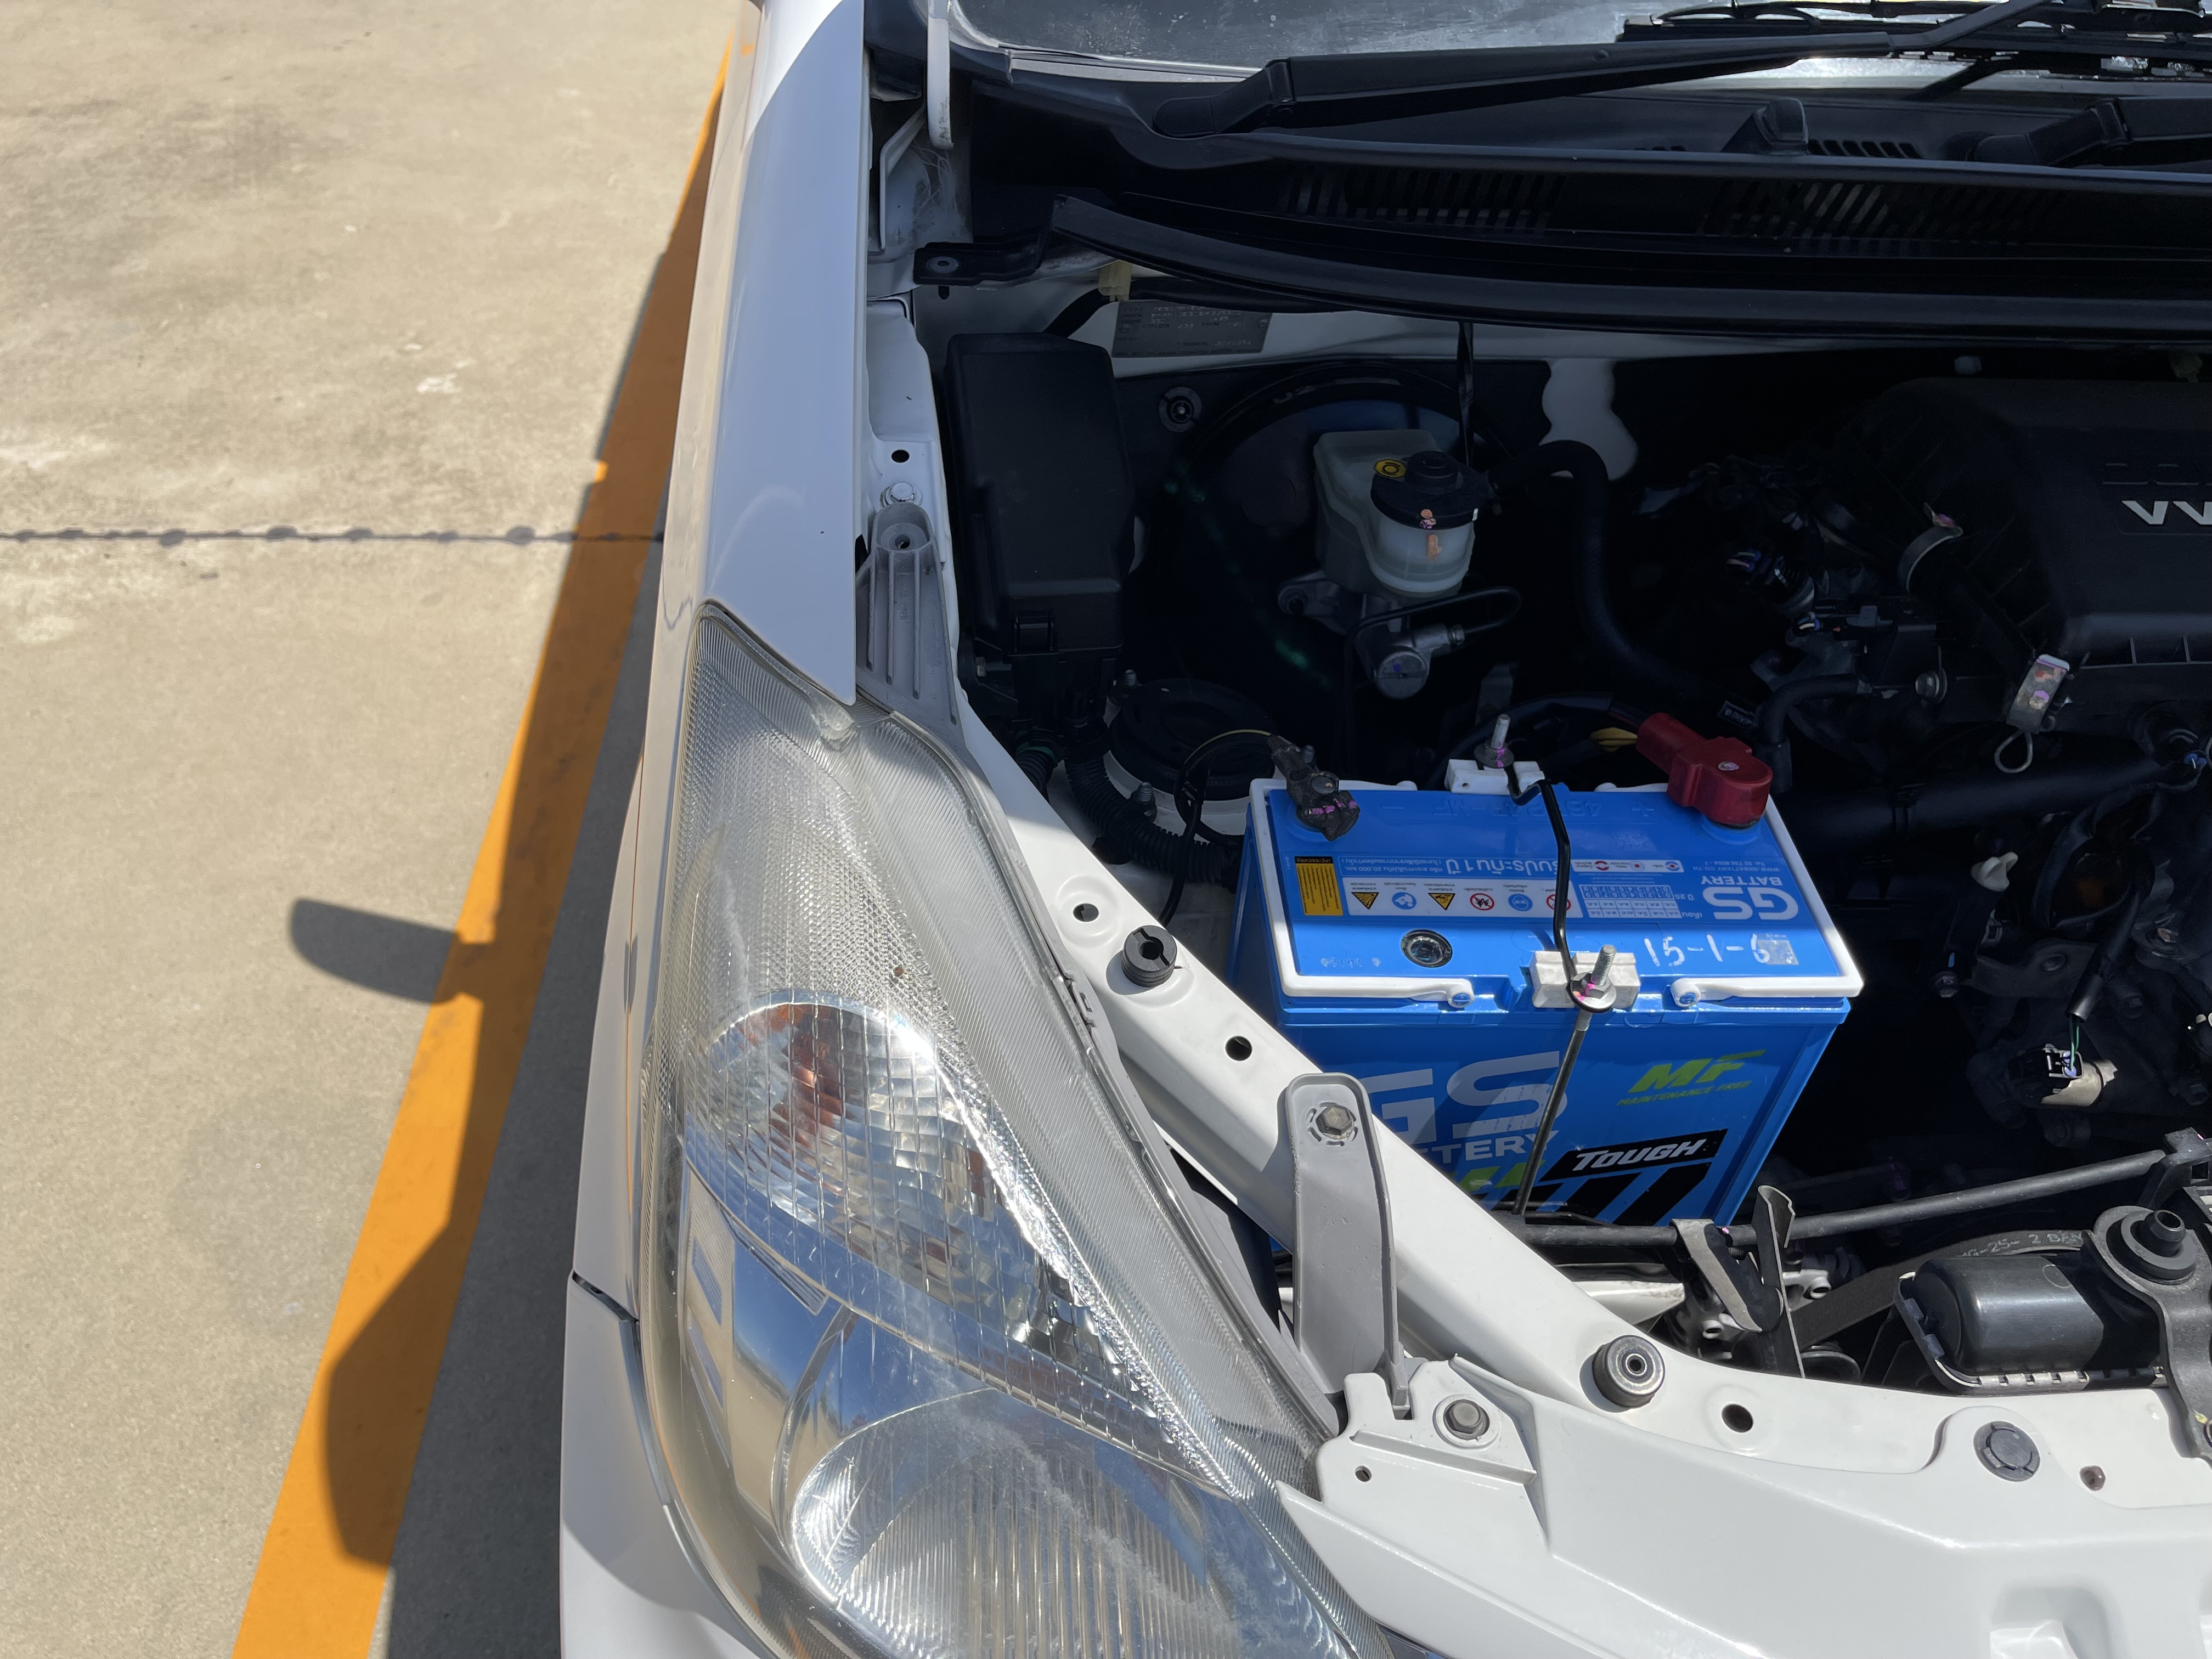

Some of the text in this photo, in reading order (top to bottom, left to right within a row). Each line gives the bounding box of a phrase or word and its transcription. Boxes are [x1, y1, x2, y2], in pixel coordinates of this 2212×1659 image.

[1700, 875, 1783, 886] BATTERY
[1702, 887, 1798, 921] GS
[1627, 1048, 1767, 1093] MF
[1358, 1050, 1568, 1145] GS
[1616, 1080, 1753, 1106] MAINTENANCE FREE
[1572, 1138, 1707, 1172] TOUGH
